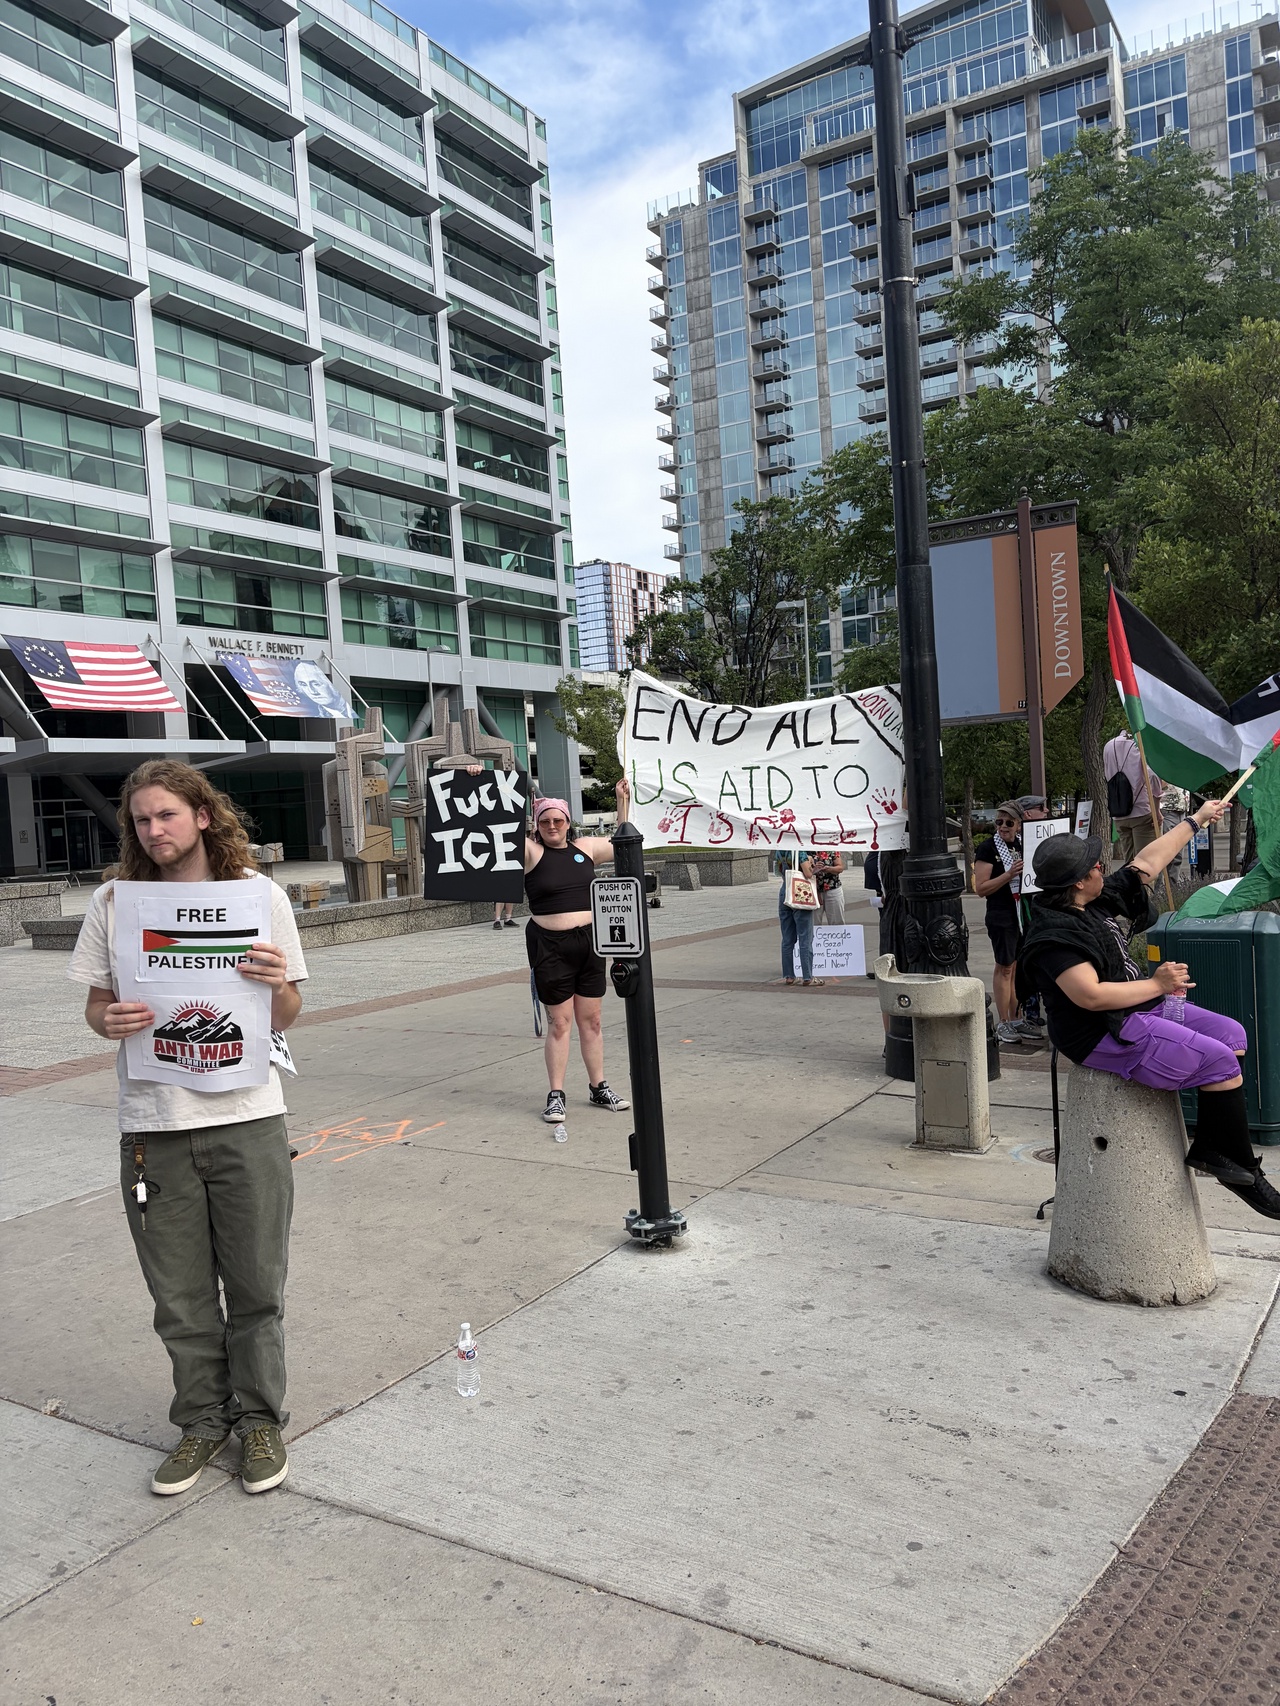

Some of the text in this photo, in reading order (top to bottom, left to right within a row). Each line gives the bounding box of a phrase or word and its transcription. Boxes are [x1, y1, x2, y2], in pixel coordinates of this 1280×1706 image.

[1050, 551, 1072, 679] DOWNTOWN
[208, 636, 304, 655] WALLACE F. BENNETT
[858, 692, 892, 720] JOIN
[632, 685, 859, 751] END ALL
[718, 765, 793, 811] AID
[801, 764, 870, 798] TO
[1036, 823, 1055, 839] END
[621, 883, 632, 891] OR
[622, 894, 633, 902] AT
[176, 908, 227, 922] FREE
[601, 905, 632, 913] BUTTON
[610, 916, 625, 924] FOR
[816, 926, 852, 940] Genocide
[826, 948, 852, 960] Embargo
[154, 1039, 243, 1060] ANTI WAR
[176, 1057, 220, 1068] COMMITTEE
